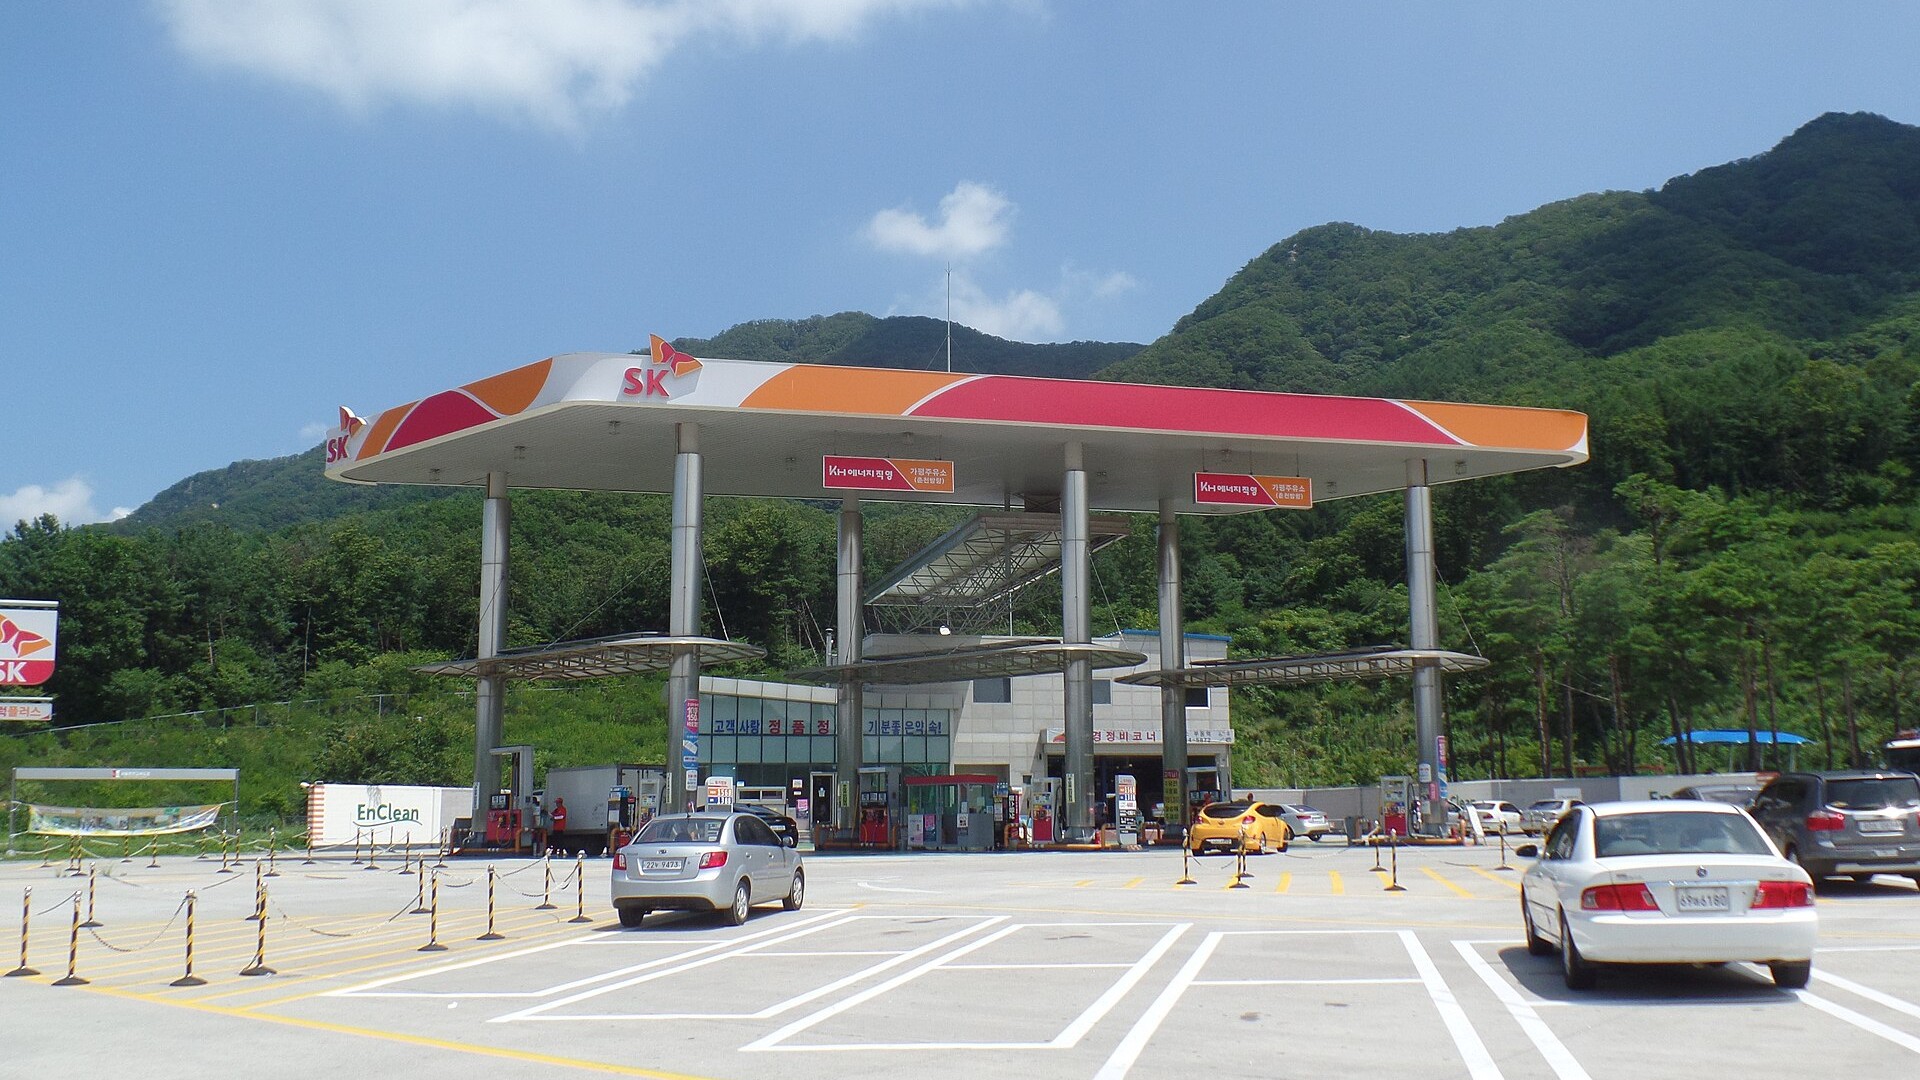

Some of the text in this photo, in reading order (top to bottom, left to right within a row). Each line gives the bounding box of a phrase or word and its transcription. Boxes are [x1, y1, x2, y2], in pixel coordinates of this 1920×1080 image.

[622, 367, 670, 398] SK
[326, 434, 349, 463] SK
[357, 802, 419, 821] EnClean
